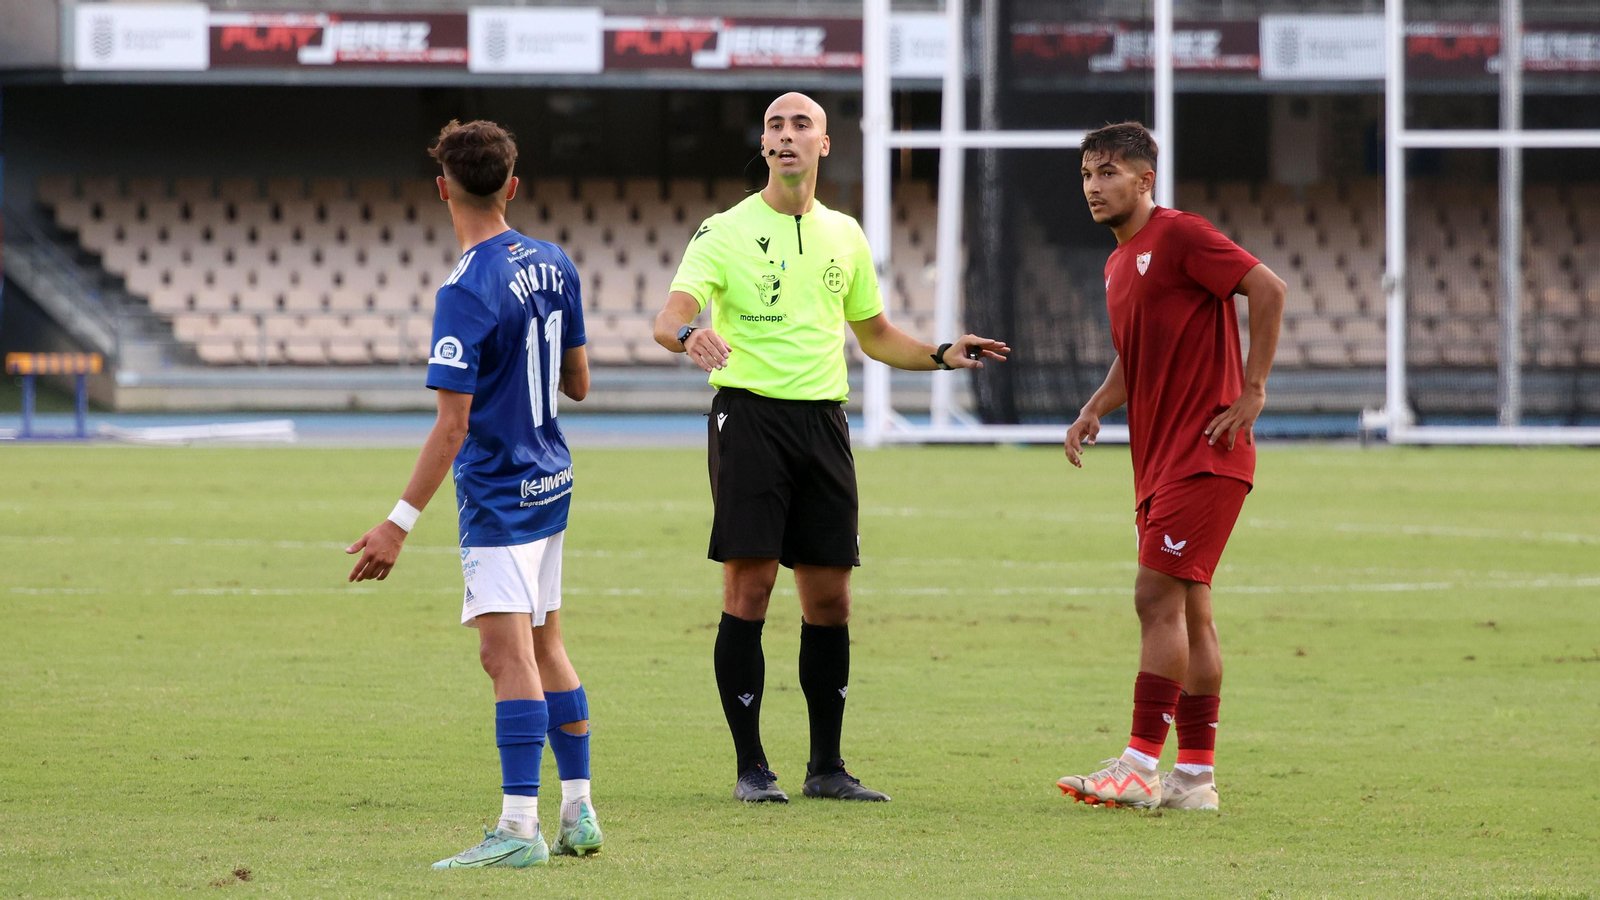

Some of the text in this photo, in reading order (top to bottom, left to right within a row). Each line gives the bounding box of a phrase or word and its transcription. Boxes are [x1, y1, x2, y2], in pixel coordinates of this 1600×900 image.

[740, 314, 783, 323] matchapp
[525, 310, 563, 428] 11
[519, 500, 544, 508] Empresa
